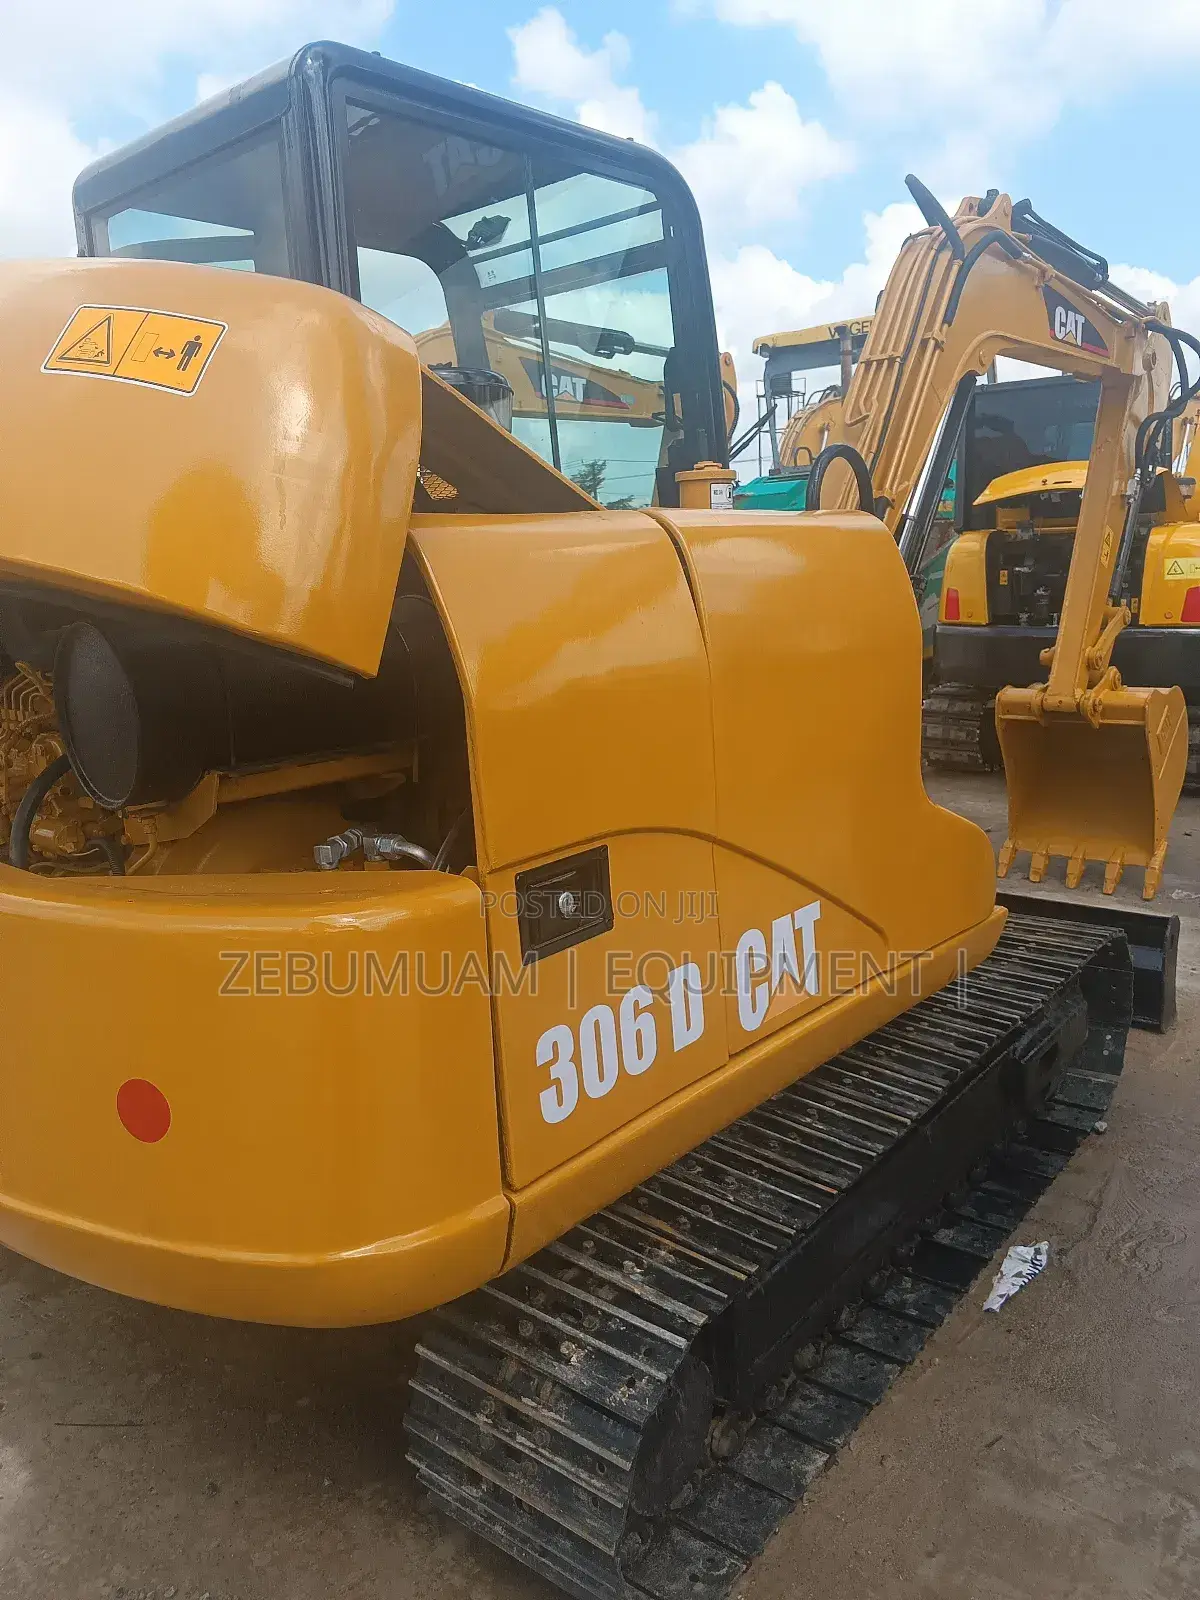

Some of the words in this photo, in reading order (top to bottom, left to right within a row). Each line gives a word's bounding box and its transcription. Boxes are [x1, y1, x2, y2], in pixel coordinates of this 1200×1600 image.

[1055, 306, 1085, 347] CAT
[541, 374, 587, 402] CAT
[536, 984, 658, 1124] 306
[668, 962, 705, 1053] D
[735, 900, 821, 1032] CAT
